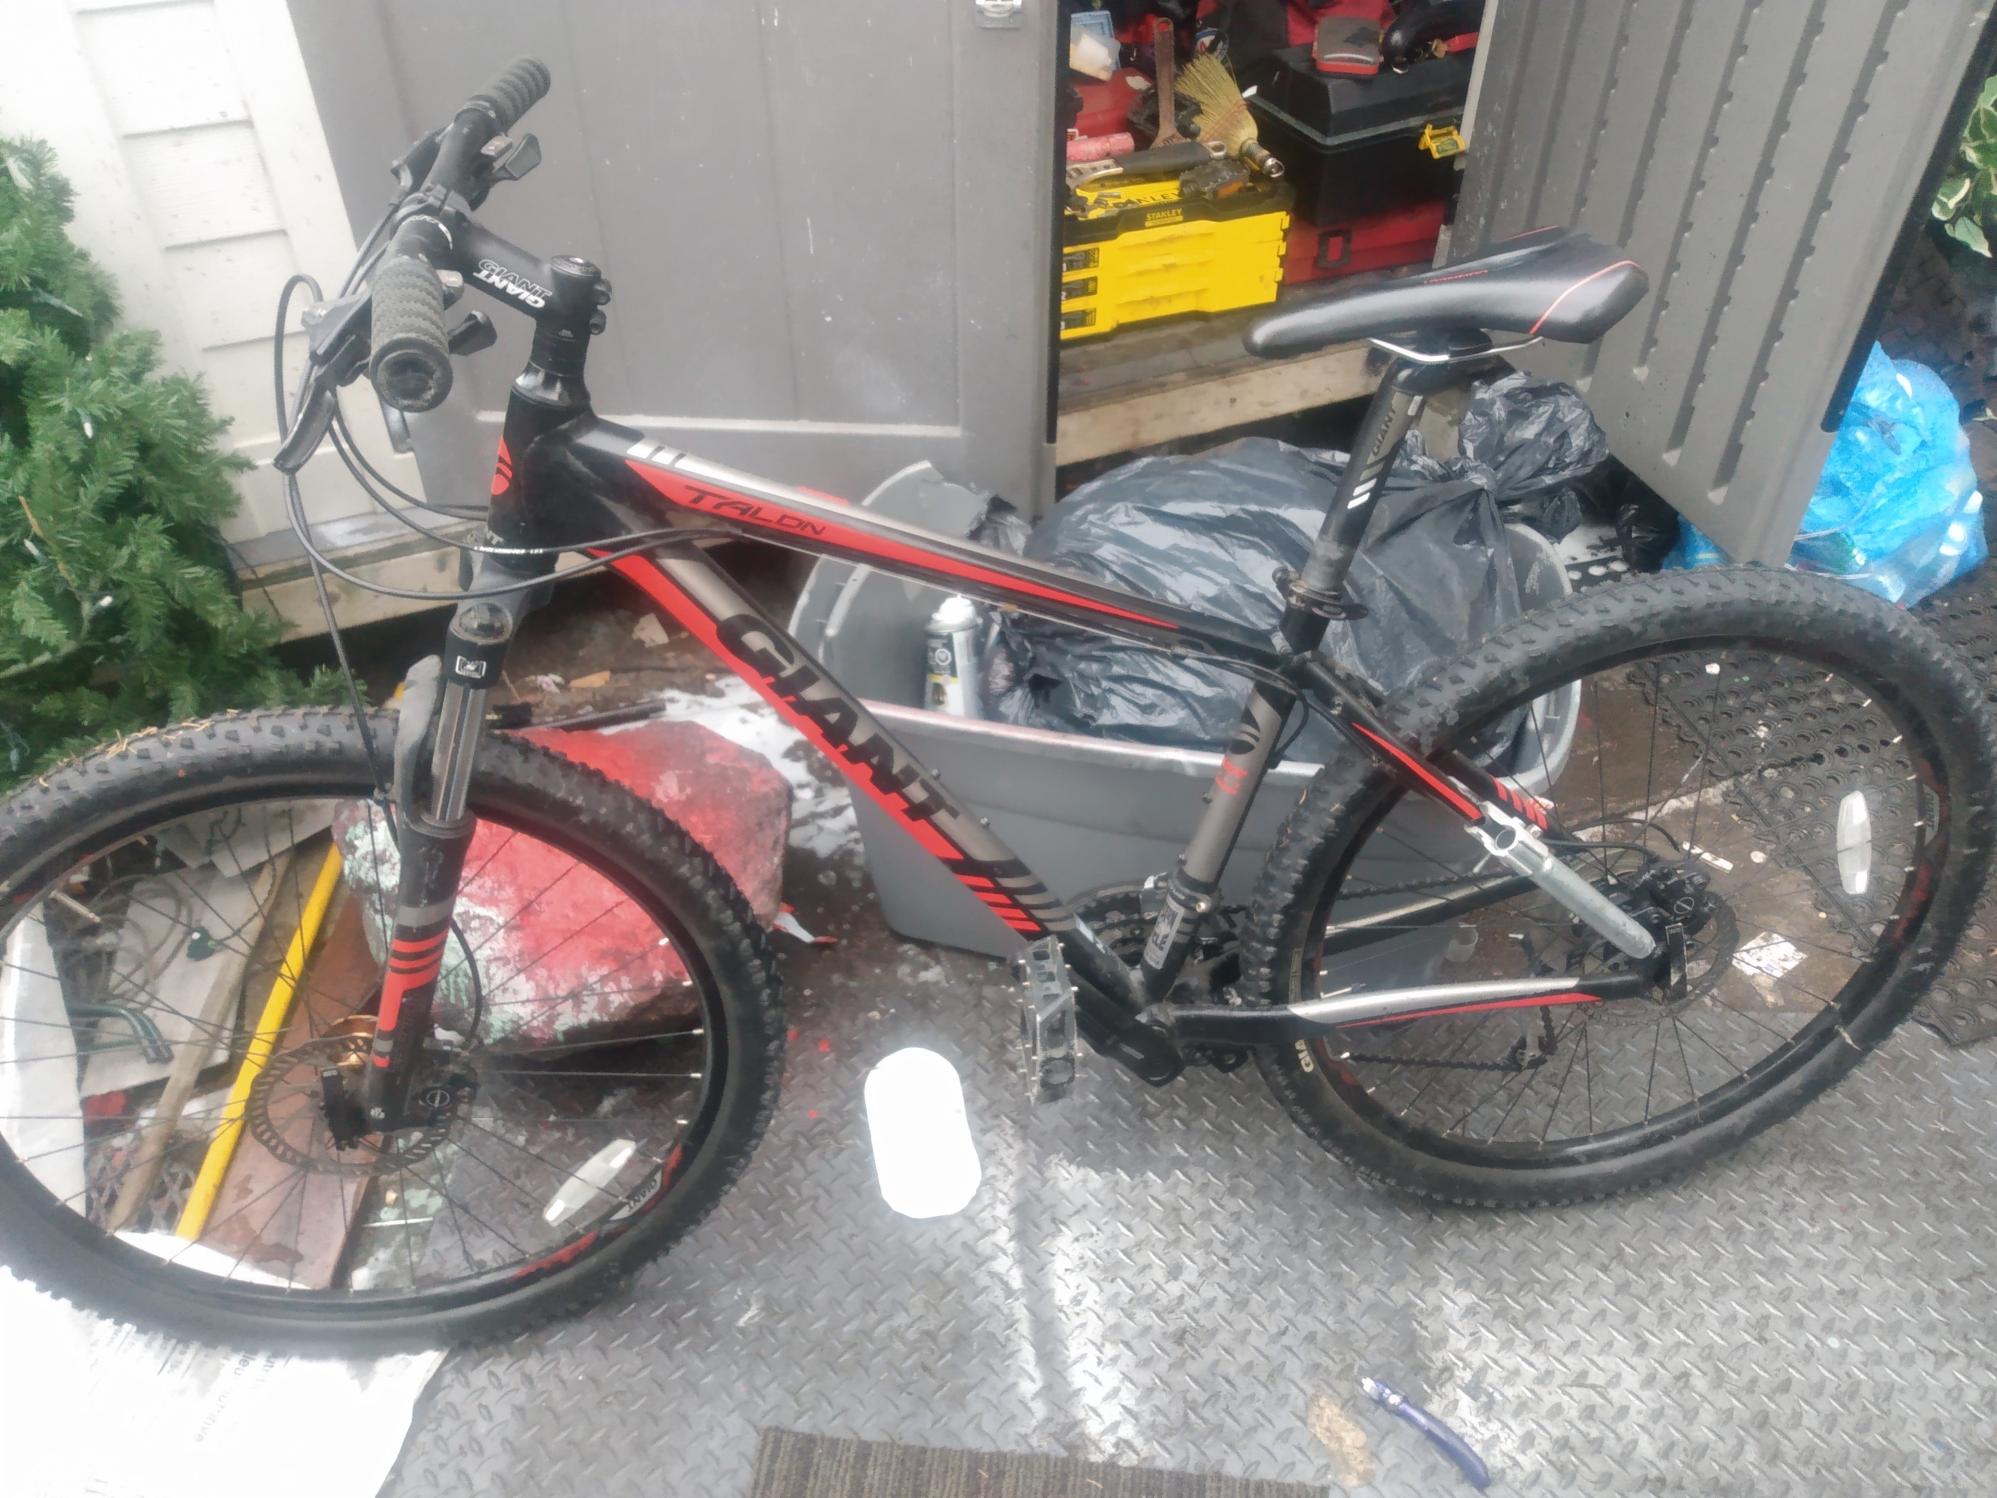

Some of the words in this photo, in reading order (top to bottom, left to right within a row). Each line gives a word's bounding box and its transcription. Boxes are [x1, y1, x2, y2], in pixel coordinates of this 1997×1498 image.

[1145, 208, 1182, 220] STANLEY
[472, 269, 547, 309] GIANT
[477, 258, 553, 298] GIANT
[1372, 407, 1397, 457] GIANT
[683, 484, 827, 536] TALON
[716, 613, 961, 823] GIANT
